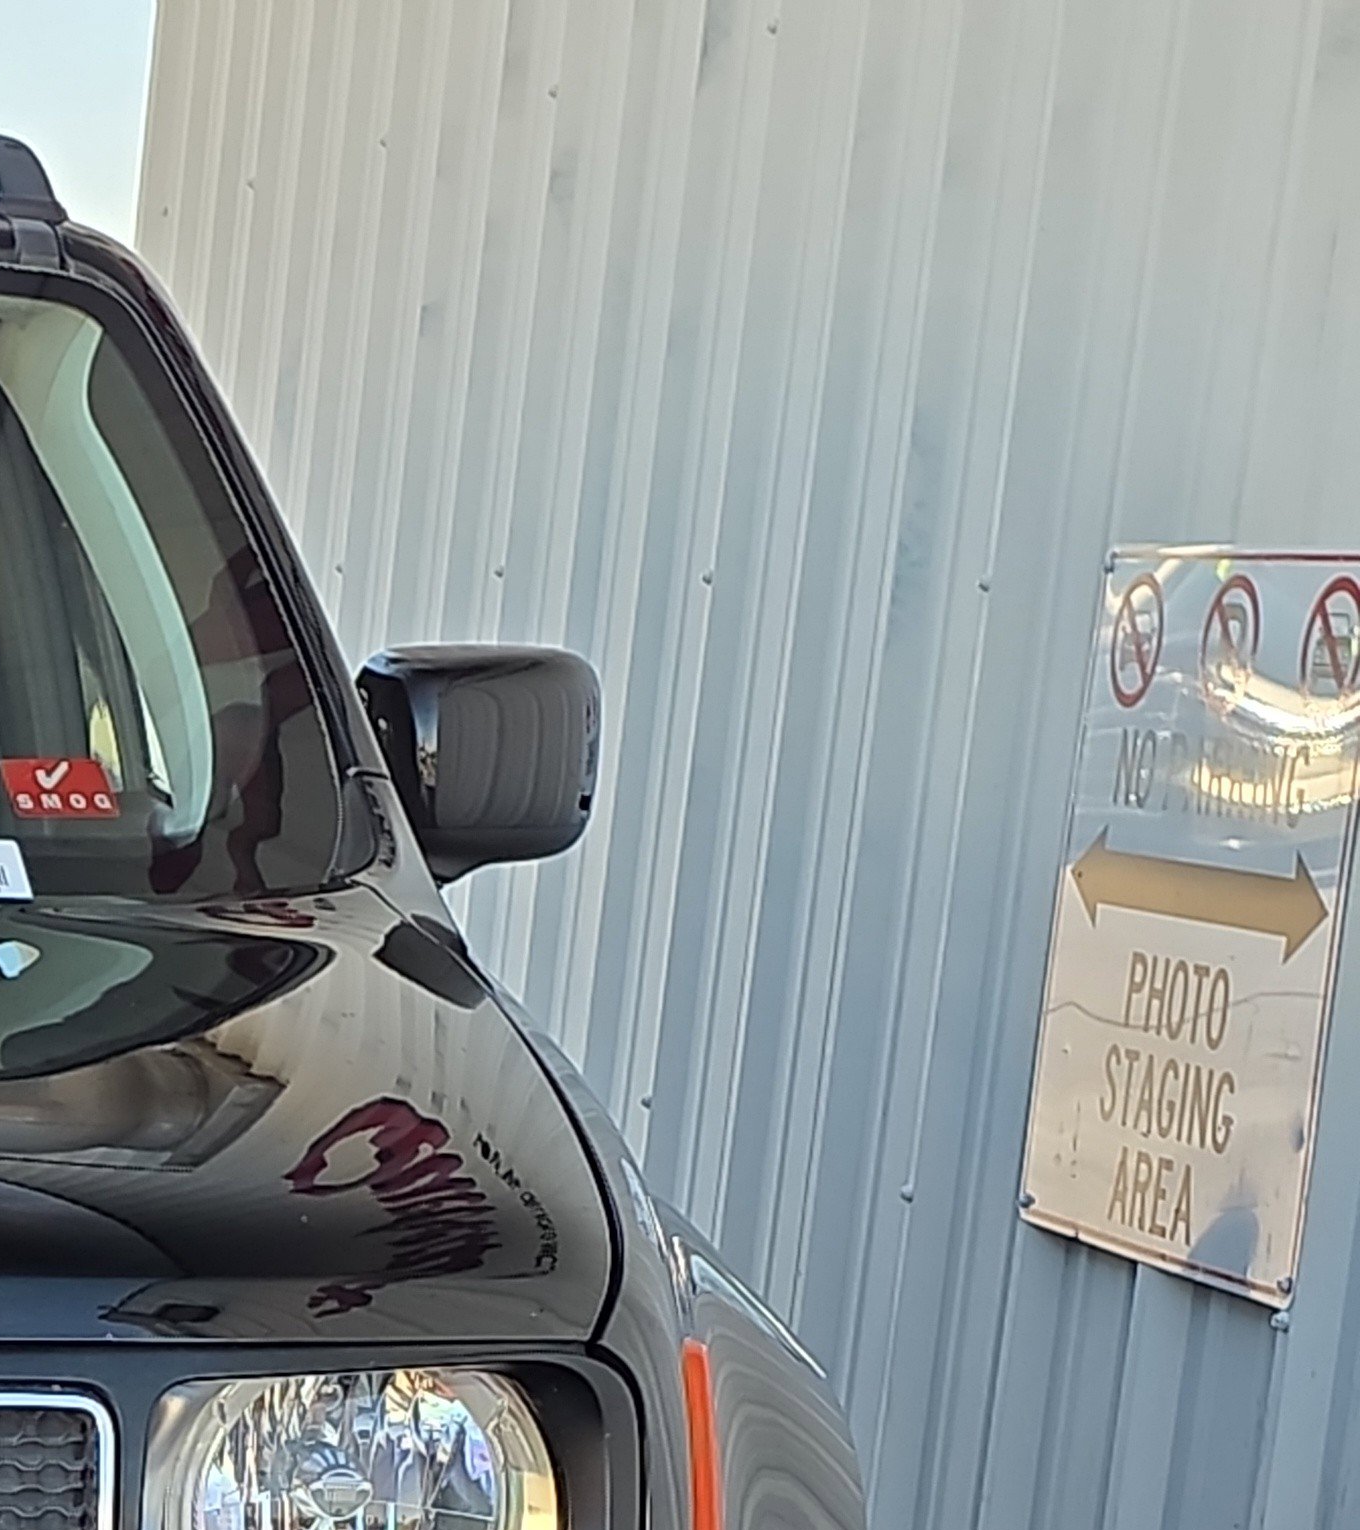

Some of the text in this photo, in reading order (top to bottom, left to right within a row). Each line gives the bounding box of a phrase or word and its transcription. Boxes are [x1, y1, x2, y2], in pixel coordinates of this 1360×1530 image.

[15, 792, 113, 810] SMOG
[1112, 727, 1157, 809] NO
[1123, 950, 1230, 1051] PHOTO
[1099, 1043, 1236, 1155] STAGING
[1106, 1145, 1192, 1247] AREA
